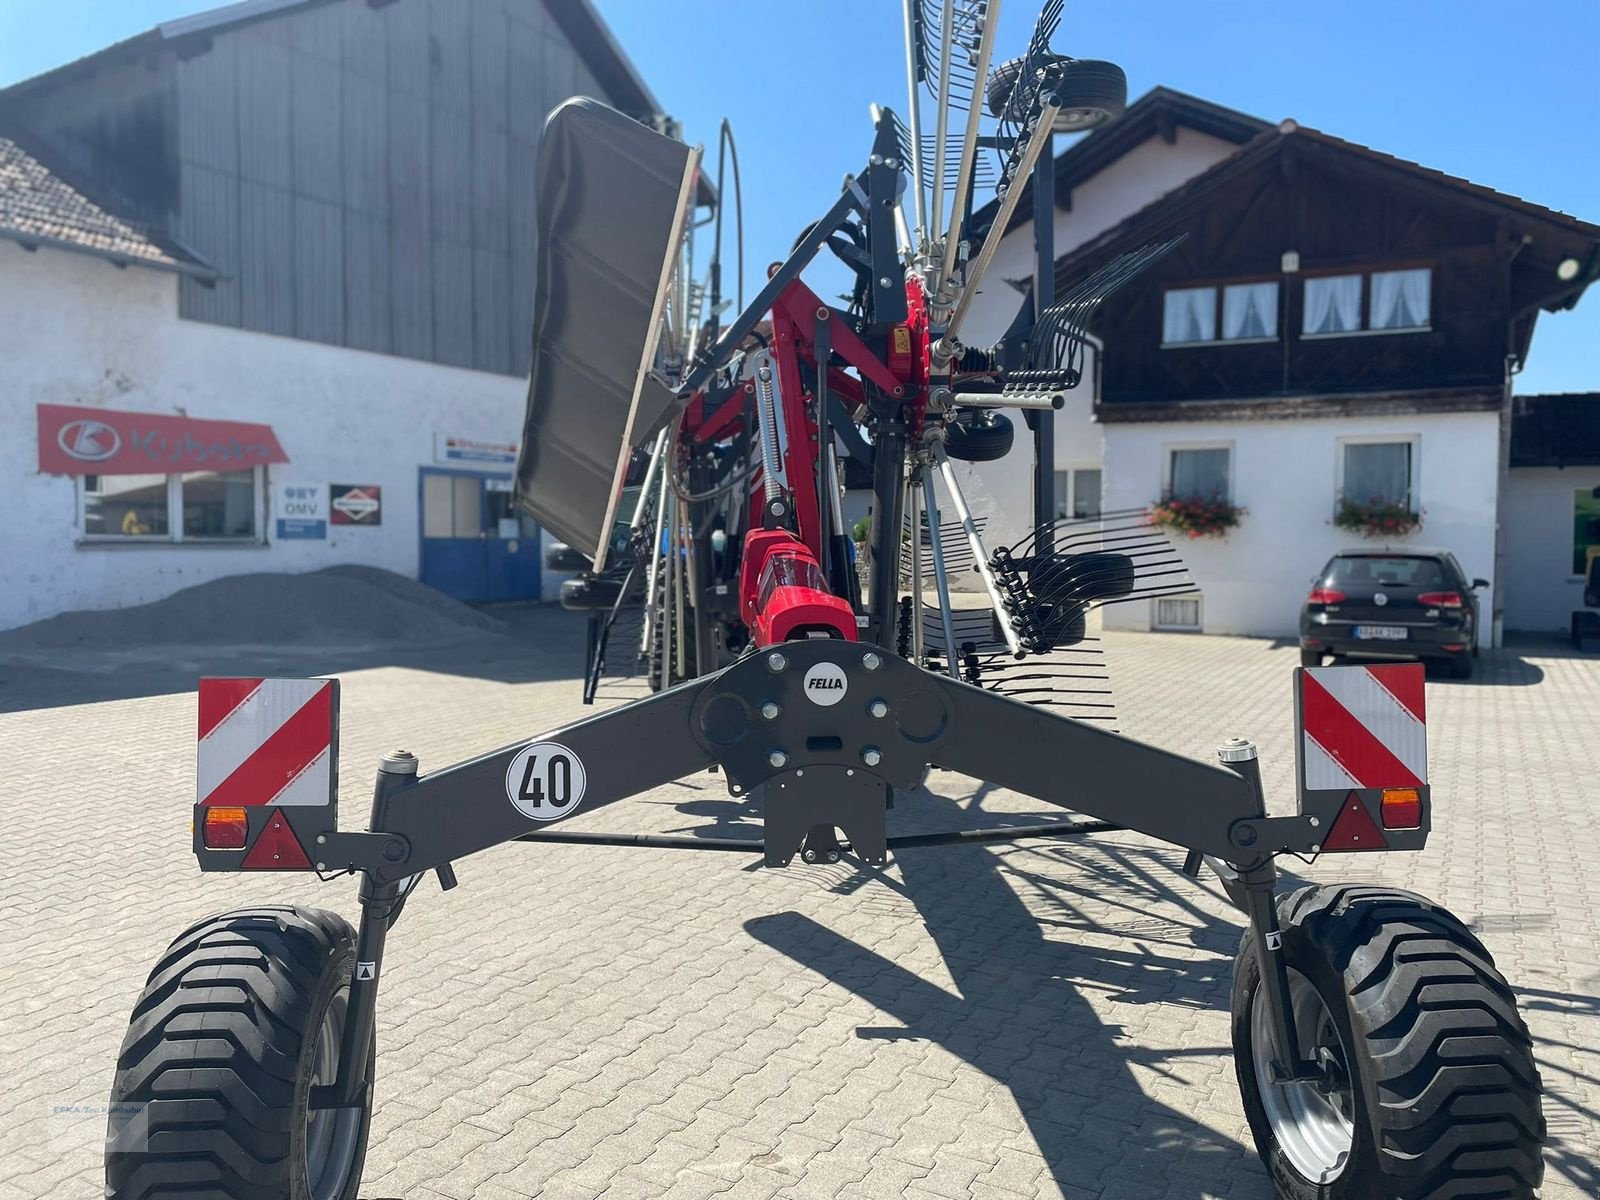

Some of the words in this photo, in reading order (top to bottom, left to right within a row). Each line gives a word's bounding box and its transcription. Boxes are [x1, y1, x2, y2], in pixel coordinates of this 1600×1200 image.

[130, 427, 271, 462] Kubota
[285, 503, 317, 514] OMV
[808, 678, 843, 689] FELLA
[518, 754, 571, 808] 40
